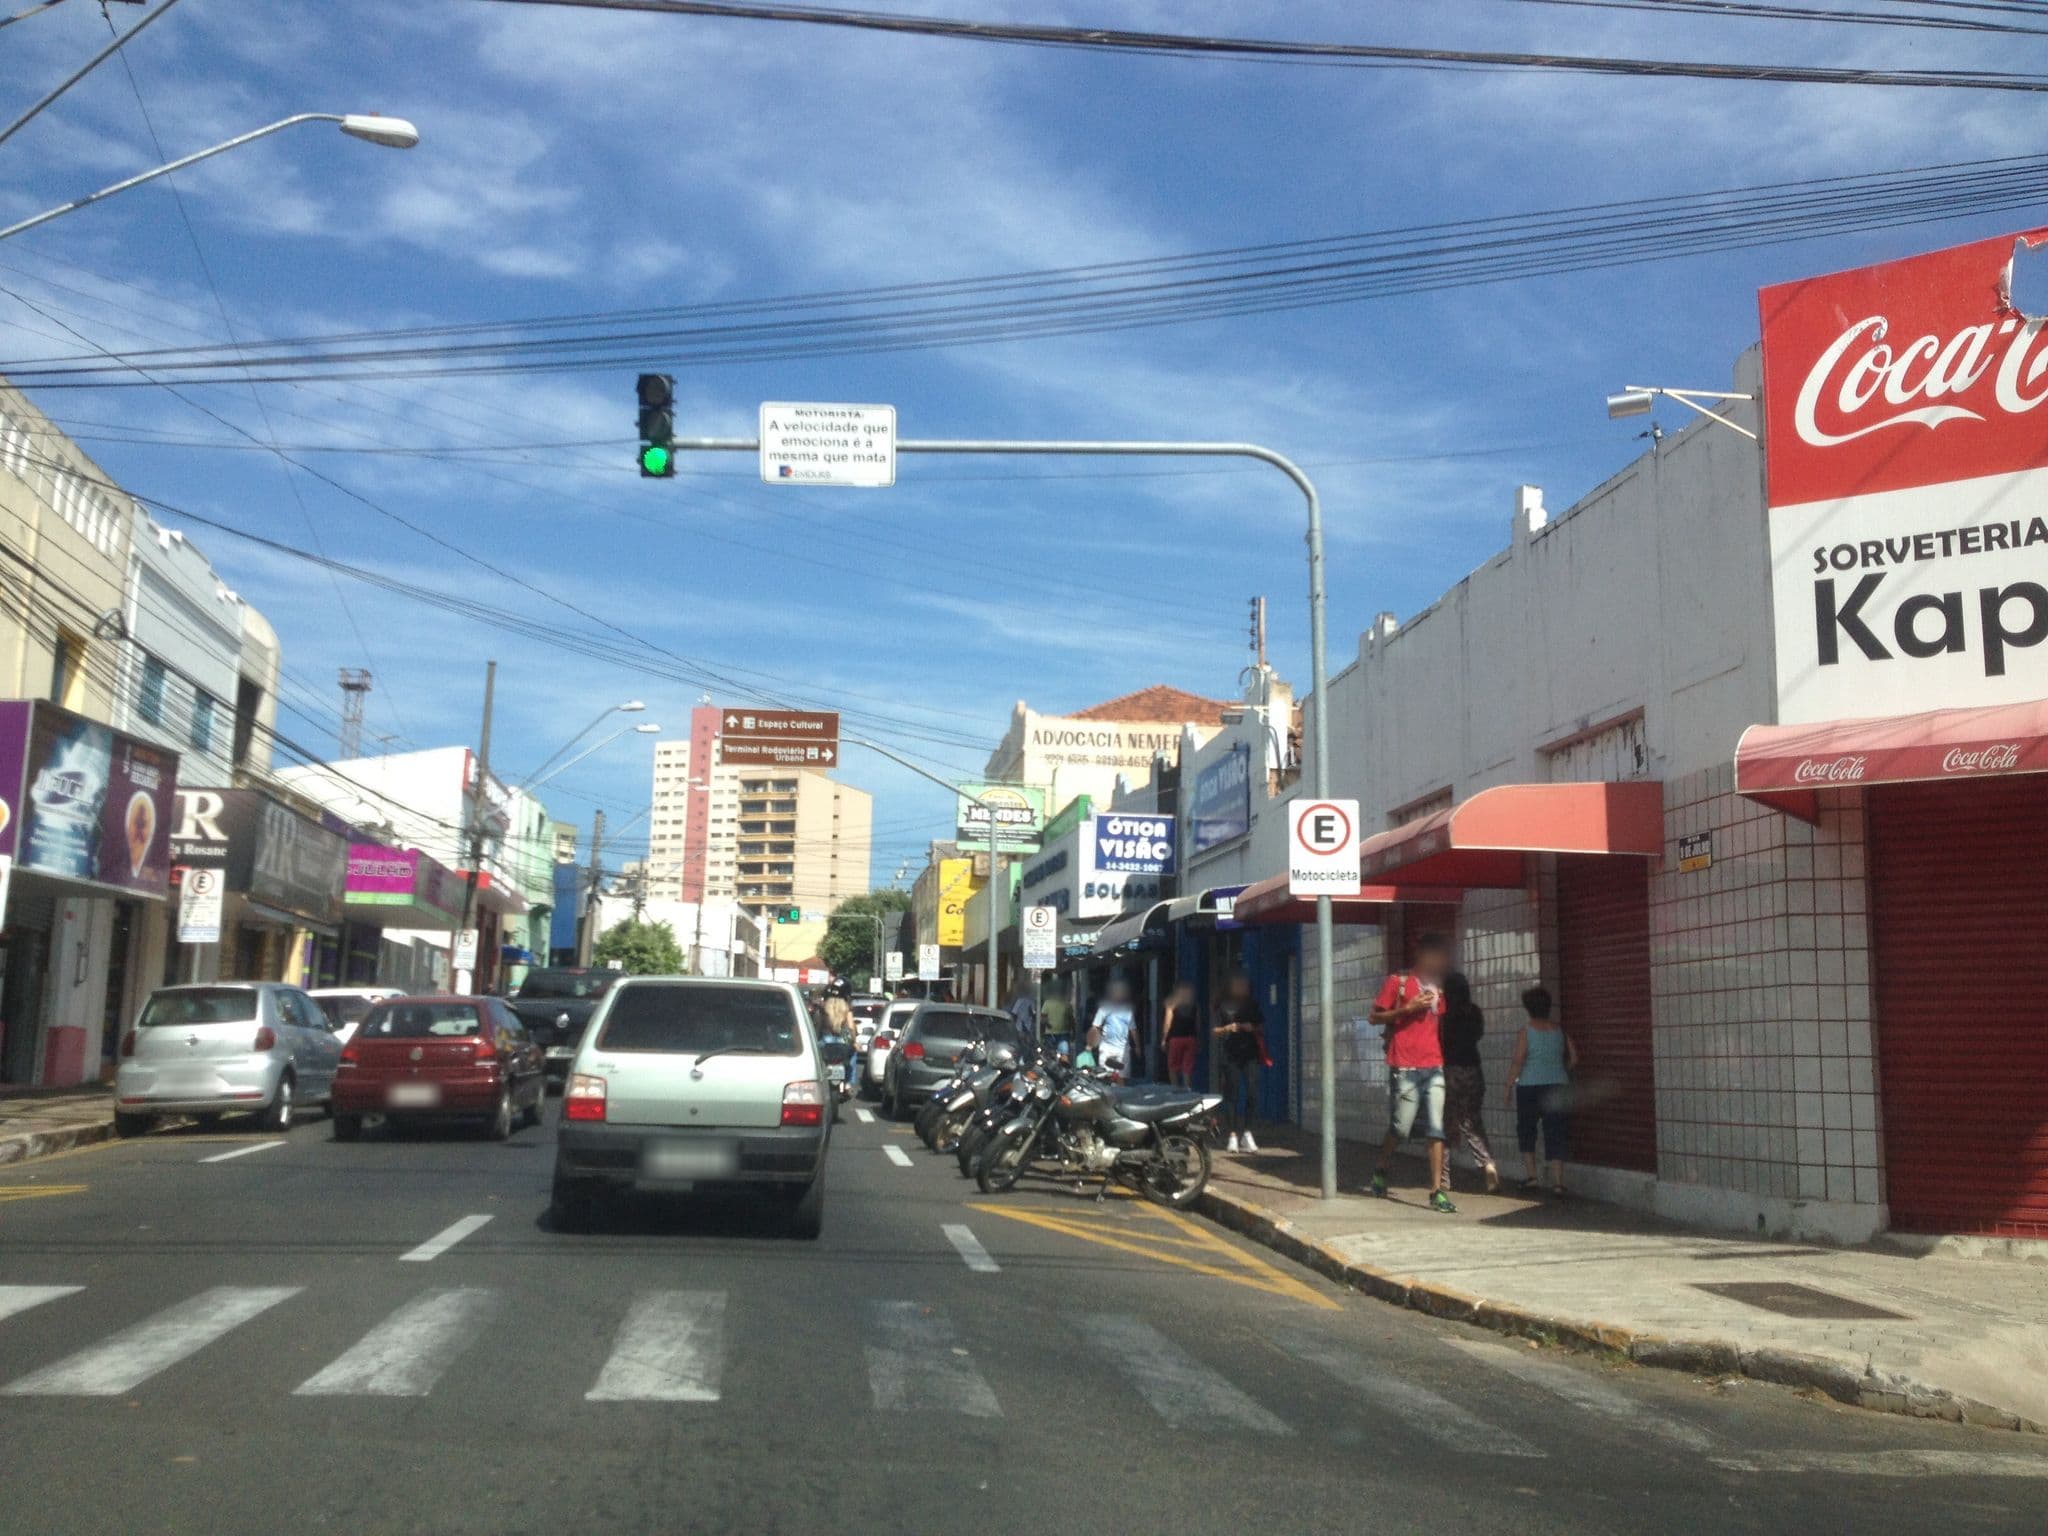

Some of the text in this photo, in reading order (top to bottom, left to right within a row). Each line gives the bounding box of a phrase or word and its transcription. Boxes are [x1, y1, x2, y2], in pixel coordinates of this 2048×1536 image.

[769, 420, 888, 435] A velocidade que
[781, 436, 873, 448] emociona é a
[769, 452, 887, 464] mesma que mata
[1813, 516, 2048, 575] SORVETERIA
[1814, 571, 2048, 678] Kap
[758, 720, 824, 730] Espaço Cultural
[724, 744, 760, 754] Terminal
[1032, 729, 1123, 749] ADVOCACIA
[775, 754, 805, 762] Urbano
[1942, 744, 2022, 772] Coca-Cola
[1793, 757, 1867, 783] Coca-Cola
[170, 790, 229, 841] R
[1107, 817, 1167, 838] ÓTICA
[1314, 815, 1335, 843] E
[1099, 837, 1172, 861] VISÃO
[1291, 868, 1359, 881] Motocicleta
[1035, 912, 1043, 923] E
